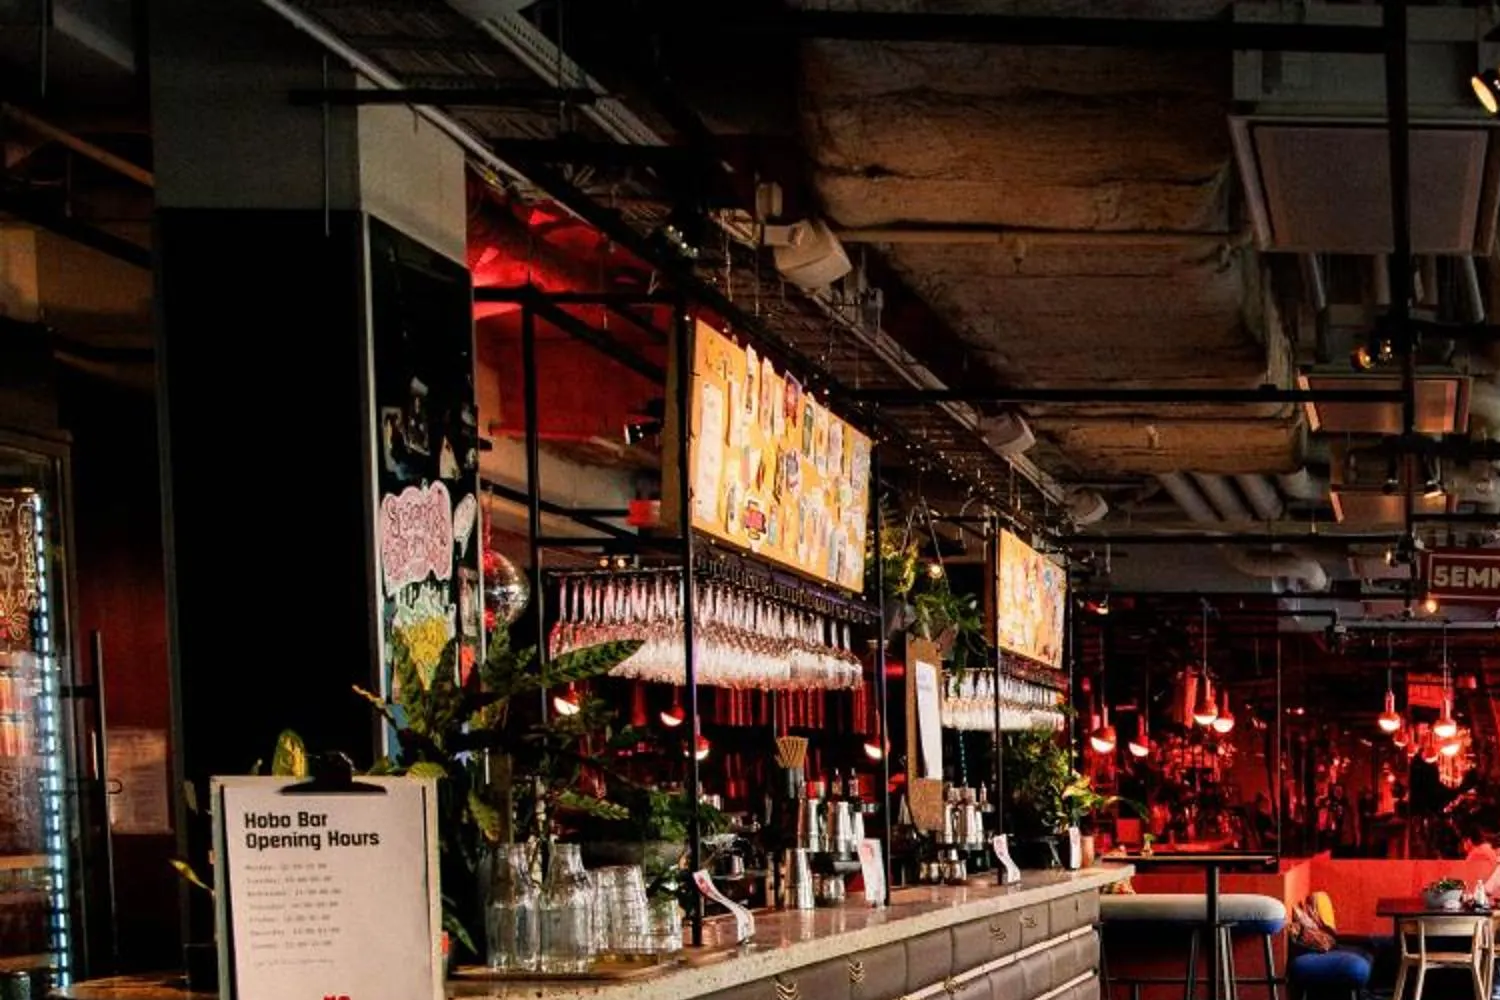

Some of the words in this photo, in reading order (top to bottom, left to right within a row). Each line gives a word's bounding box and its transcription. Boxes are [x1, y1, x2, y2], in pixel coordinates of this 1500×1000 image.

[244, 812, 291, 829] Hobo
[298, 811, 328, 827] Bar
[246, 831, 321, 851] Opening
[328, 830, 380, 847] Hours
